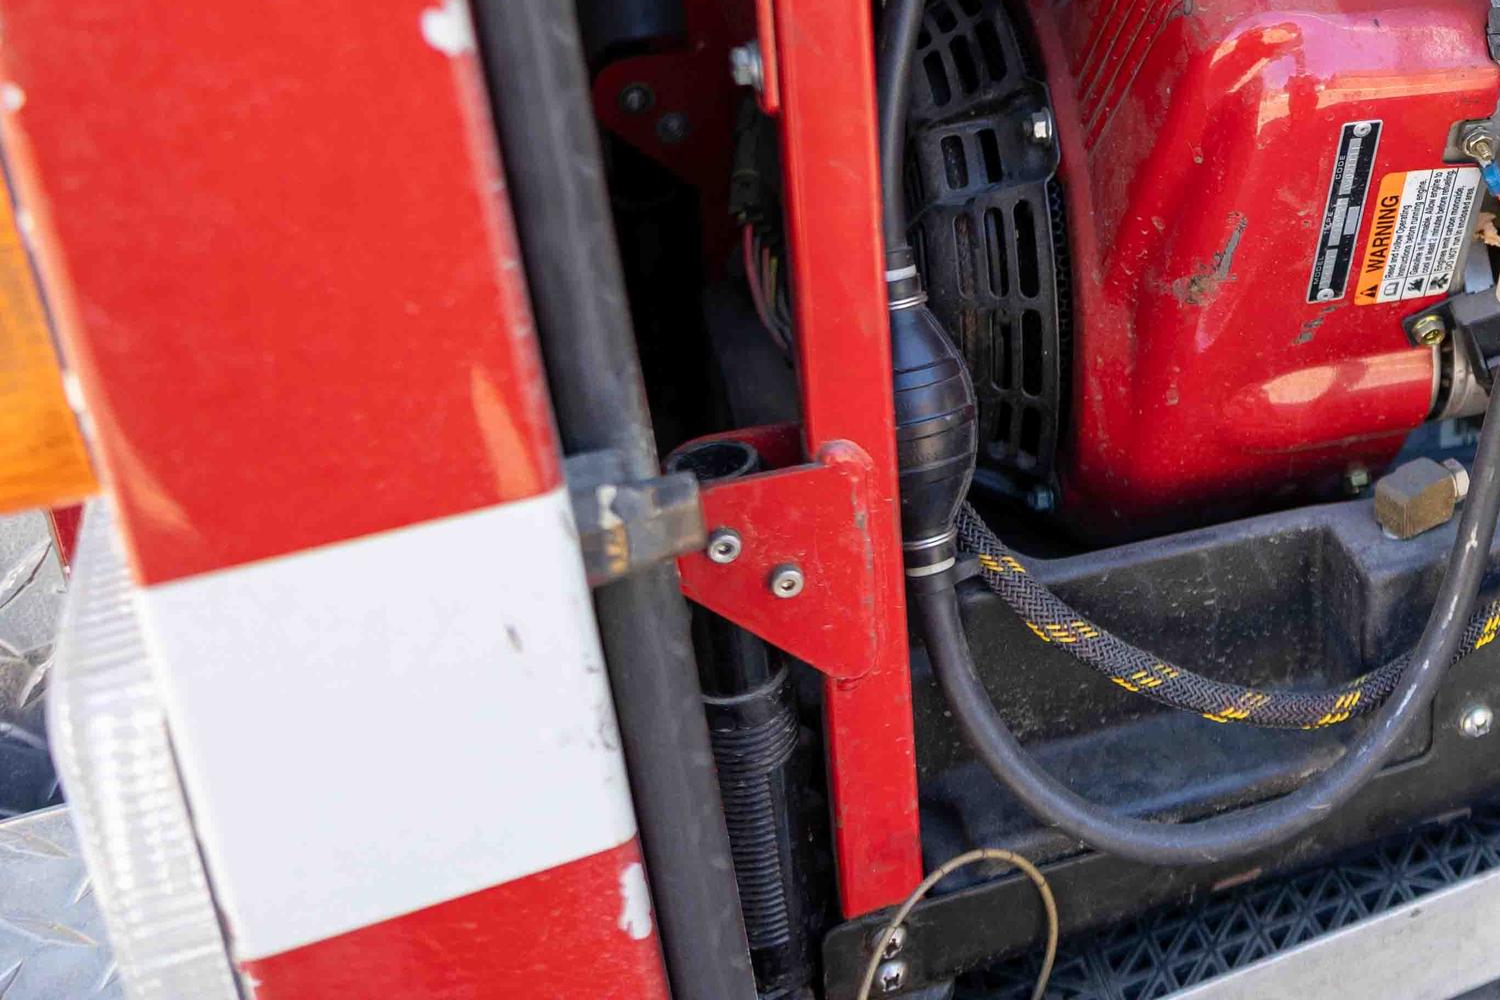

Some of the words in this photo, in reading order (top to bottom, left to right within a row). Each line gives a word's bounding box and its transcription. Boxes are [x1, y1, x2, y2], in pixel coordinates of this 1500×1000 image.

[1335, 155, 1346, 180] CODE
[1429, 179, 1443, 198] engine
[1408, 201, 1425, 225] running
[1424, 199, 1437, 215] Allow
[1435, 196, 1448, 215] before
[1395, 204, 1413, 234] Operating
[1431, 215, 1443, 237] minutes
[1444, 216, 1457, 236] carbon
[1366, 195, 1400, 272] WARNING
[1404, 225, 1417, 244] before
[1447, 247, 1459, 260] NOT
[1456, 201, 1471, 229] enclosed
[1391, 234, 1403, 252] follow
[1425, 242, 1437, 255] least
[1441, 237, 1451, 250] emit
[1390, 252, 1399, 263] and
[1409, 252, 1423, 275] Gasoline
[1433, 249, 1449, 272] Engines
[1313, 256, 1324, 285] MODEL
[1384, 264, 1396, 279] Read
[1421, 262, 1431, 273] cool
